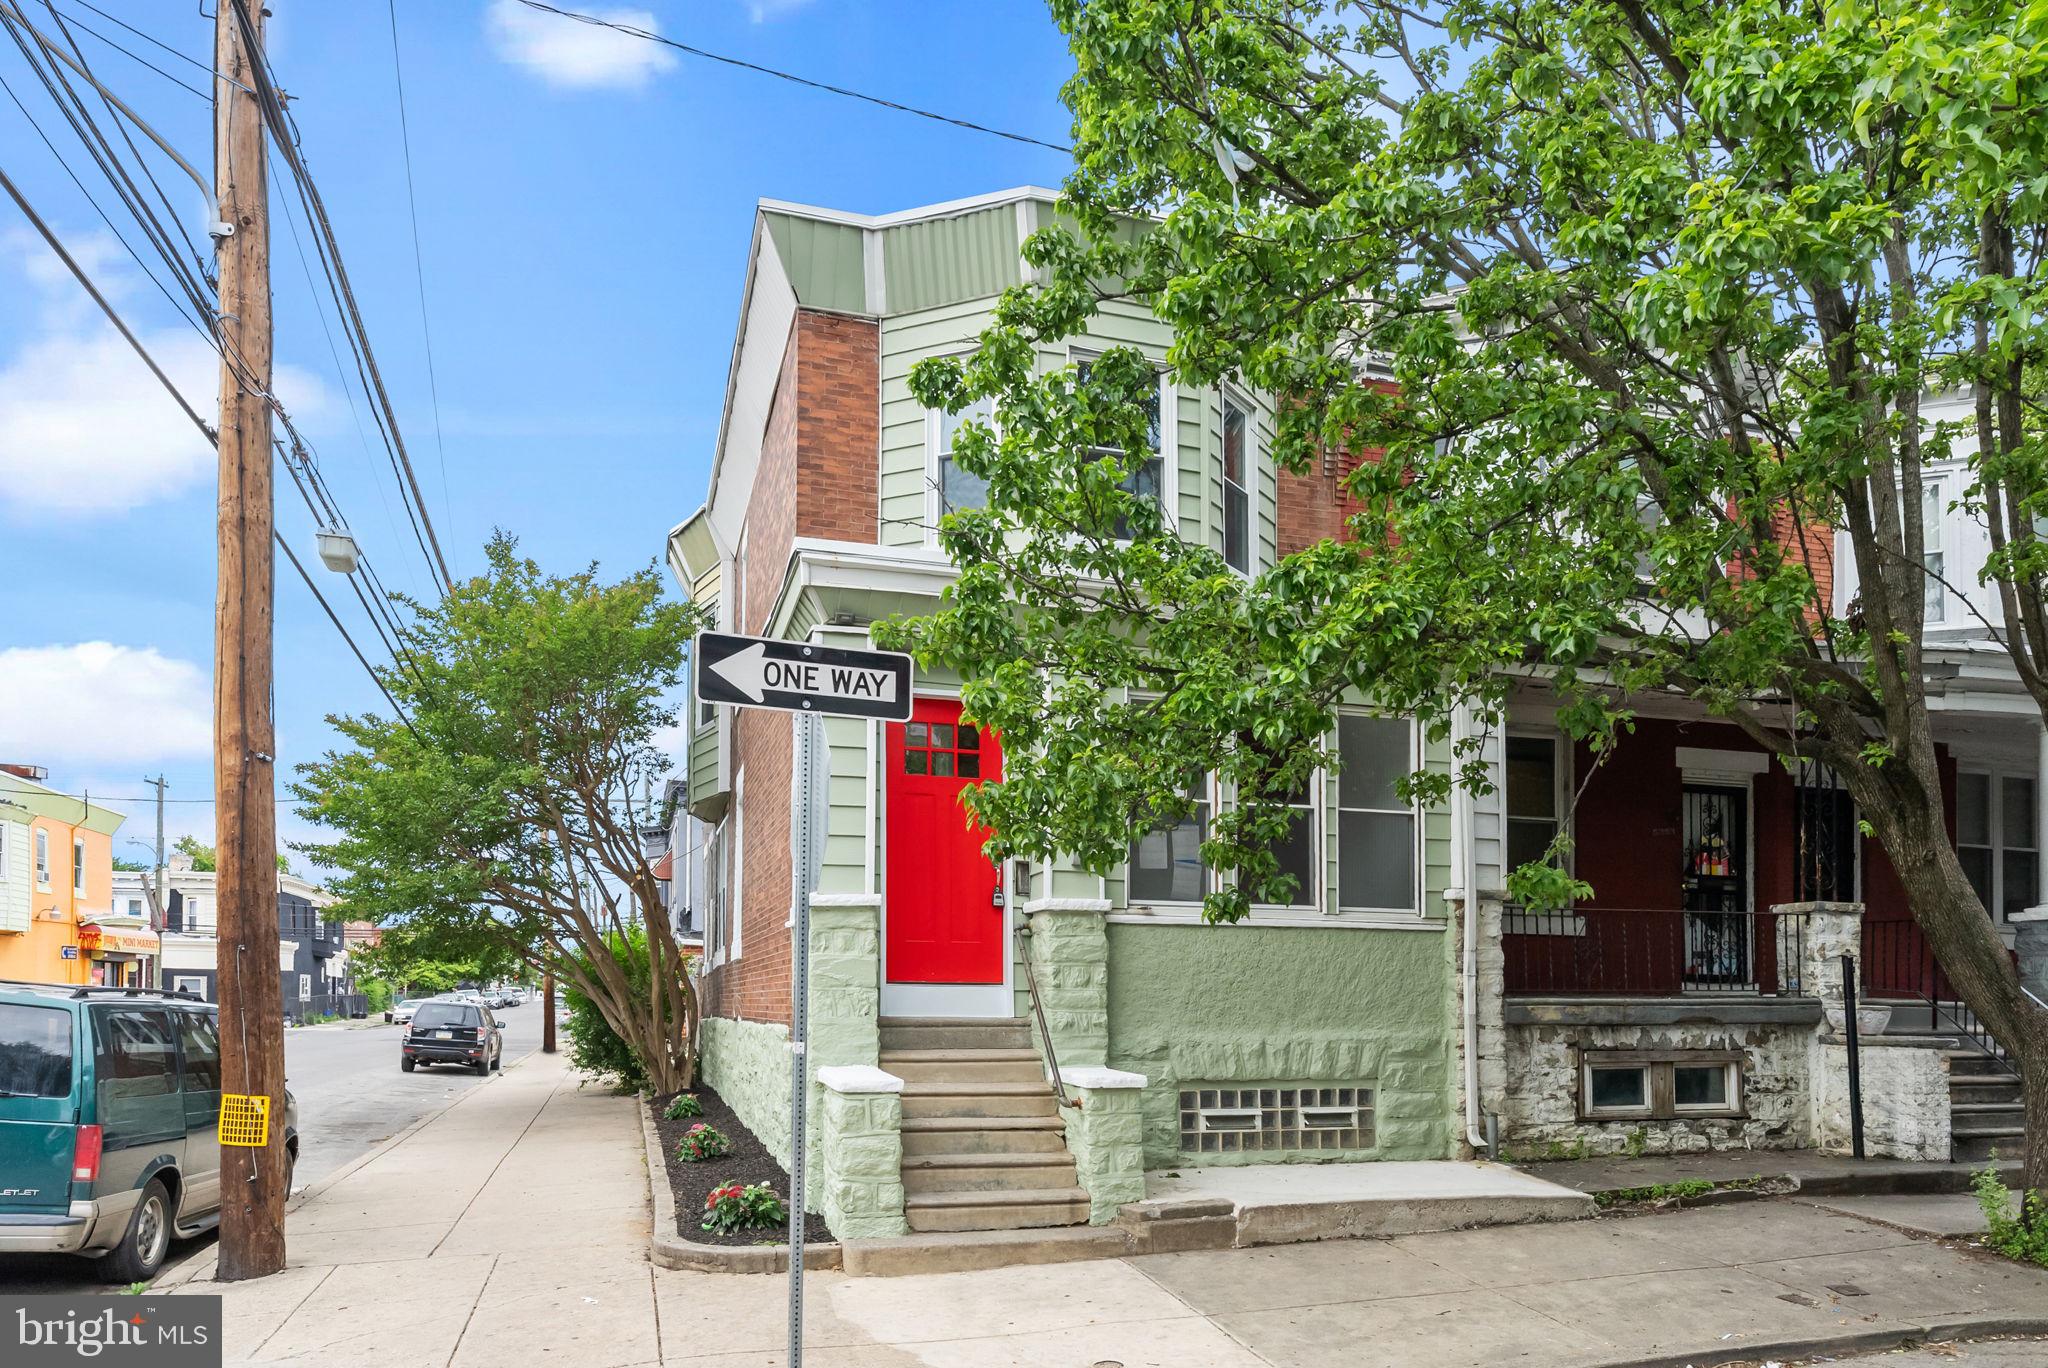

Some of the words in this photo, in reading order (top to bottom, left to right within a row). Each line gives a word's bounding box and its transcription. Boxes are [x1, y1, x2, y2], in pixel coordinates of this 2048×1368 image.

[763, 661, 820, 692] ONE
[831, 668, 889, 697] WAY
[122, 937, 136, 947] MINI
[137, 938, 159, 949] MARKET
